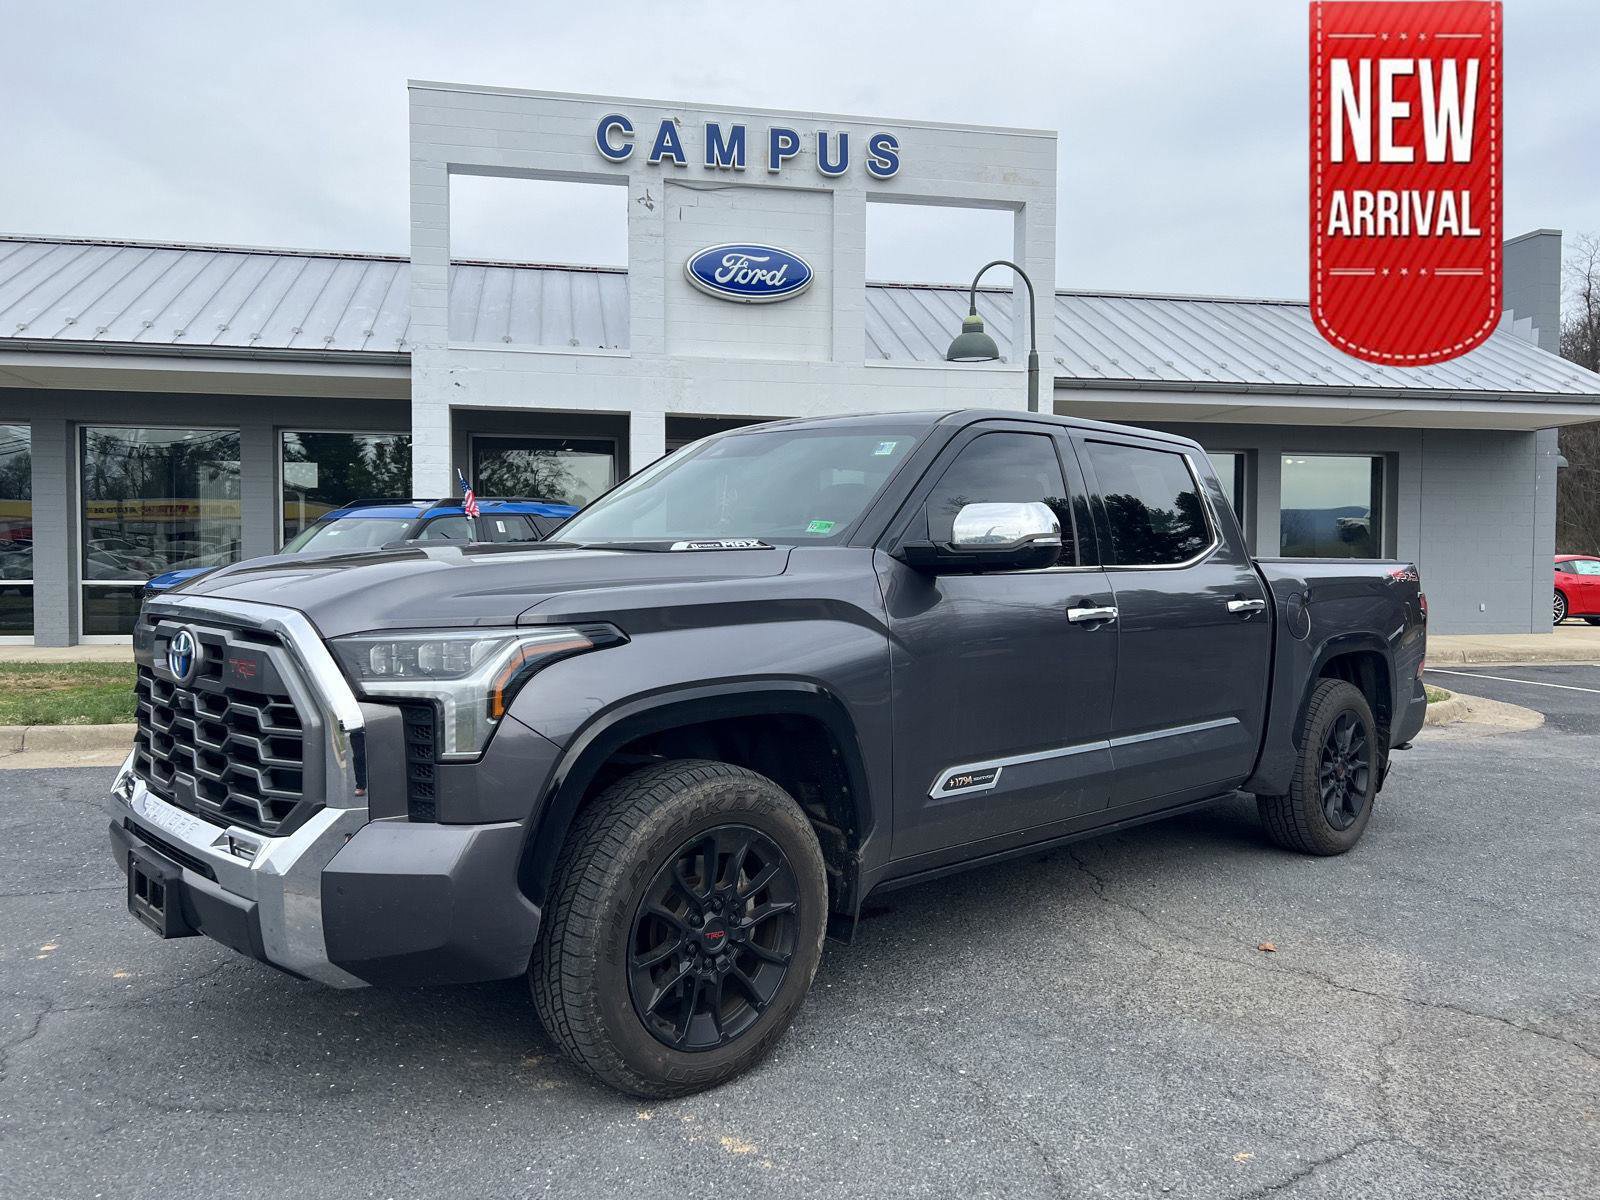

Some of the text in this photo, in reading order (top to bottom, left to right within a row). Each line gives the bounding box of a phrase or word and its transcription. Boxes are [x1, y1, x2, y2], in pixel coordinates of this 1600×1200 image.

[595, 113, 901, 179] CAMPUS
[714, 253, 787, 287] Ford
[956, 775, 973, 787] 1794
[704, 930, 726, 940] TRD
